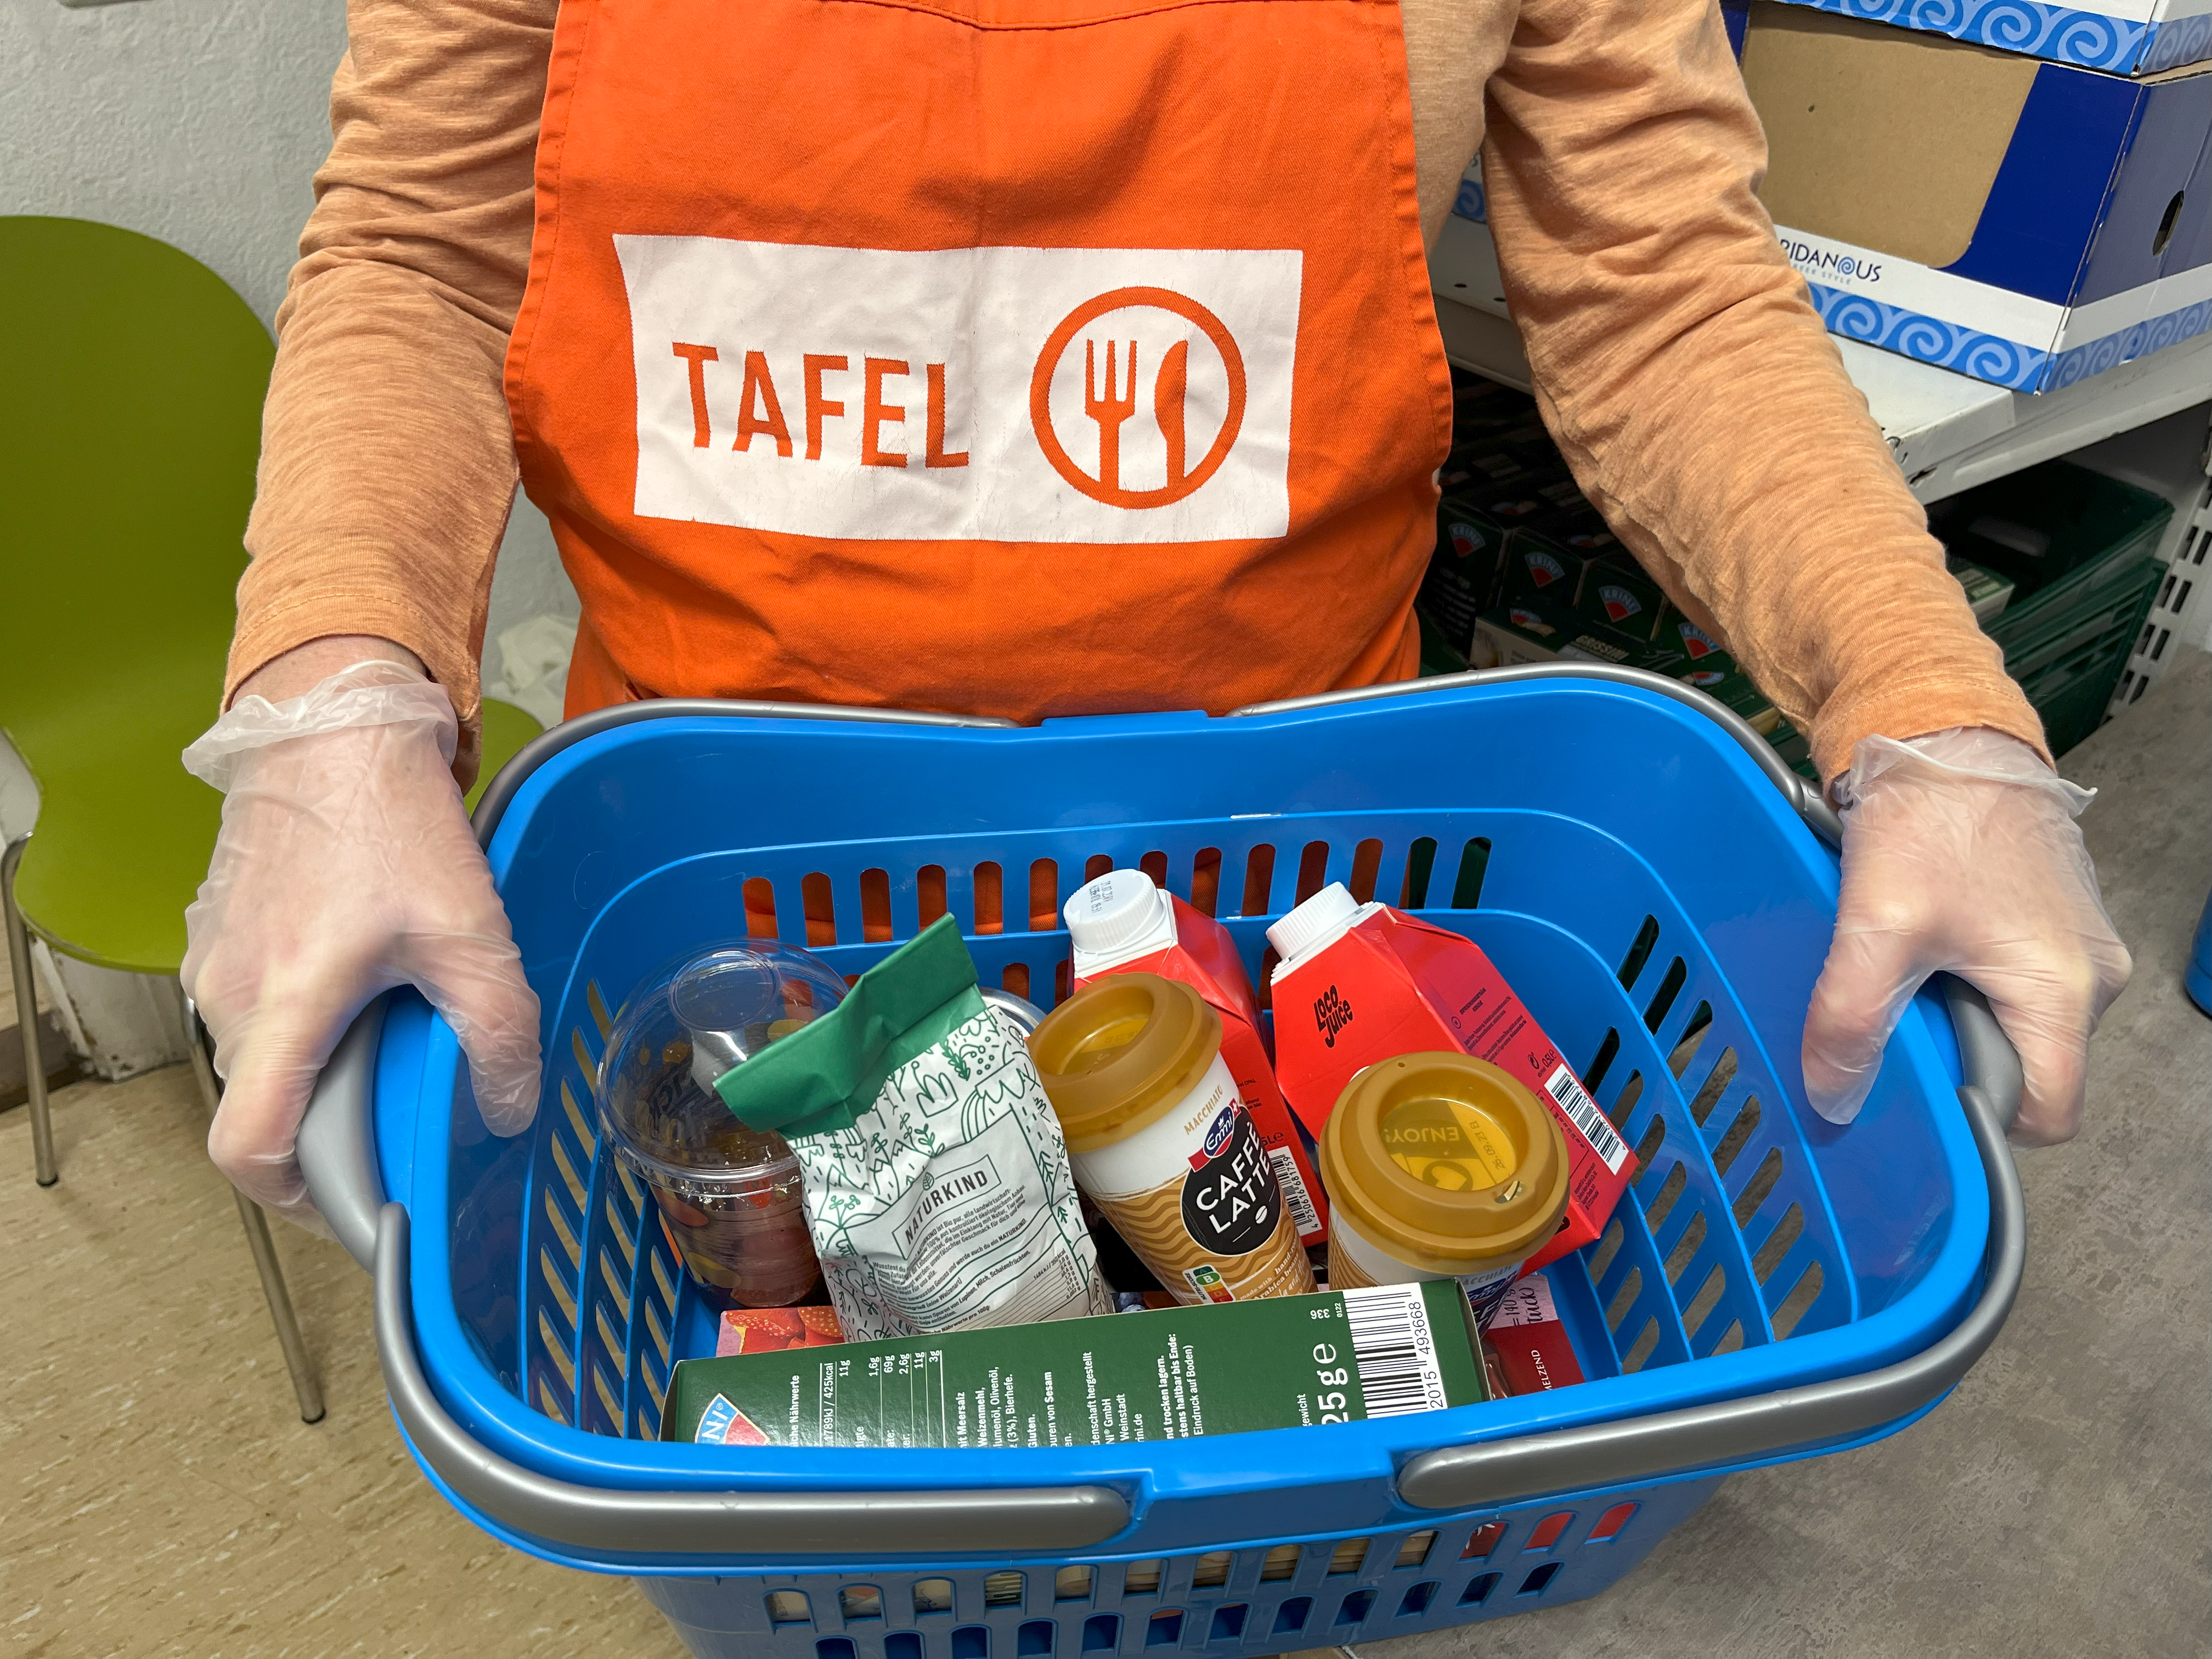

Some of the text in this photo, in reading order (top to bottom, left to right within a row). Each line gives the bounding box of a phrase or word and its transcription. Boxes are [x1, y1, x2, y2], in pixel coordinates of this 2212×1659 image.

[673, 342, 969, 468] TAFEL
[1184, 1084, 1223, 1135] MACCHIATO
[1206, 1111, 1233, 1150] Emmi
[1283, 1156, 1302, 1186] 681759
[905, 1169, 988, 1245] NATURKIND
[1209, 1147, 1270, 1234] LATTE
[1297, 1189, 1316, 1220] 250616
[963, 1210, 974, 1219] alle
[961, 1224, 991, 1243] Geschmack
[1203, 1275, 1214, 1284] B
[1240, 1277, 1273, 1300] made with
[1310, 1308, 1330, 1320] 336
[1334, 1302, 1344, 1318] 0122
[1408, 1302, 1430, 1355] 493668
[839, 1359, 851, 1378] 11g
[868, 1356, 880, 1377] 1,6g
[883, 1355, 895, 1373] 69g
[898, 1353, 910, 1375] 2,6g
[913, 1351, 925, 1369] 11g
[928, 1350, 940, 1363] 3g
[1157, 1355, 1169, 1388] lagern.
[823, 1362, 834, 1399] 425kcal
[988, 1367, 1000, 1406] Olivenöl,
[1044, 1372, 1054, 1403] Sesam
[1082, 1351, 1097, 1400] hergestellt
[1167, 1333, 1189, 1438] stens haltbar bis Ende:
[1182, 1344, 1204, 1436] Eindruck auf Boden)
[789, 1374, 800, 1424] Nährwerte
[1003, 1373, 1015, 1415] Bierhefe.
[1160, 1389, 1172, 1426] trocken
[823, 1408, 834, 1441] 1789kJ
[956, 1391, 967, 1435] Meersalz
[975, 1387, 988, 1447] Weizenmehl,
[1006, 1415, 1019, 1442] (3%),
[1047, 1404, 1056, 1421] von
[1101, 1398, 1113, 1427] GmbH
[1116, 1393, 1130, 1441] Weinstadt
[1028, 1413, 1038, 1448] Gluten.
